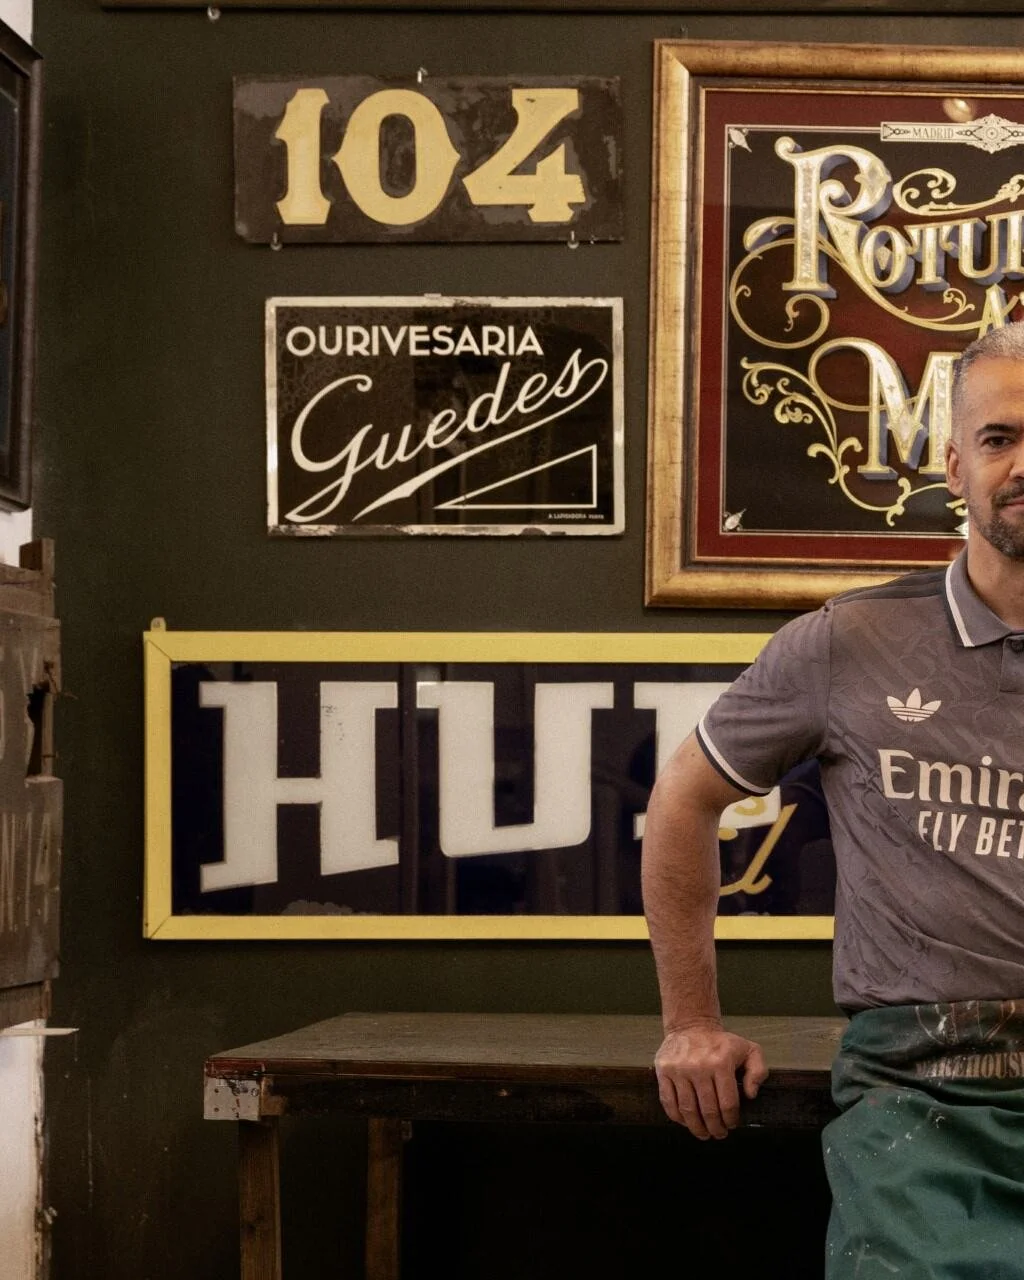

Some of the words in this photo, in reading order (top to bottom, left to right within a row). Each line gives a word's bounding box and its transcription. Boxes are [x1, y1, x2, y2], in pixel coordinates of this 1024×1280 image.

[912, 127, 954, 138] MADRID
[275, 88, 586, 225] 104
[286, 325, 543, 357] OURIVESARIA
[284, 349, 607, 522] Guedes
[917, 810, 968, 853] FLY
